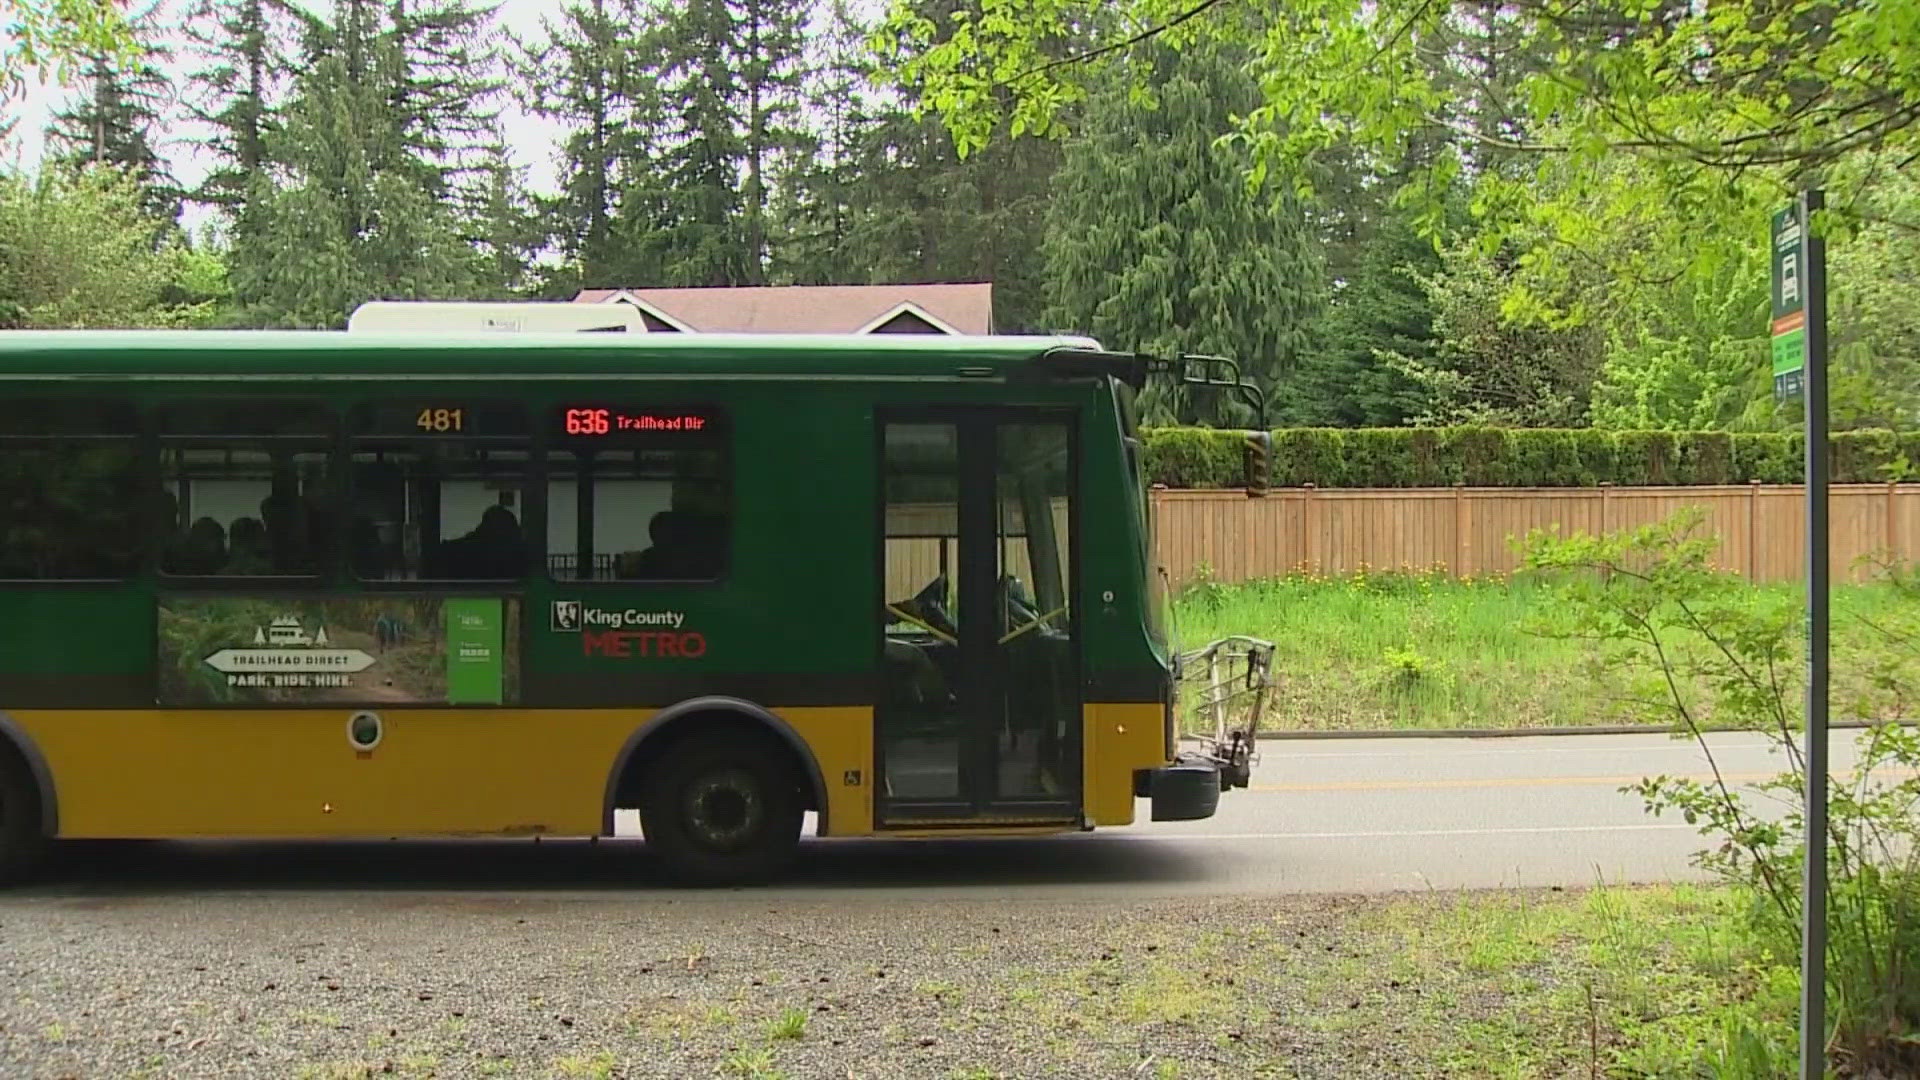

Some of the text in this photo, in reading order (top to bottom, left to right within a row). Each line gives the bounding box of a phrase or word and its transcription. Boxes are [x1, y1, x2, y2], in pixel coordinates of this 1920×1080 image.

[416, 408, 463, 433] 481
[565, 408, 706, 434] 636 Trailhead Dir
[583, 609, 684, 629] King County
[583, 632, 707, 657] METRO
[233, 655, 349, 666] TRAILHEAD DIRECT
[227, 675, 354, 687] PARK. RIDE. HIKE.
